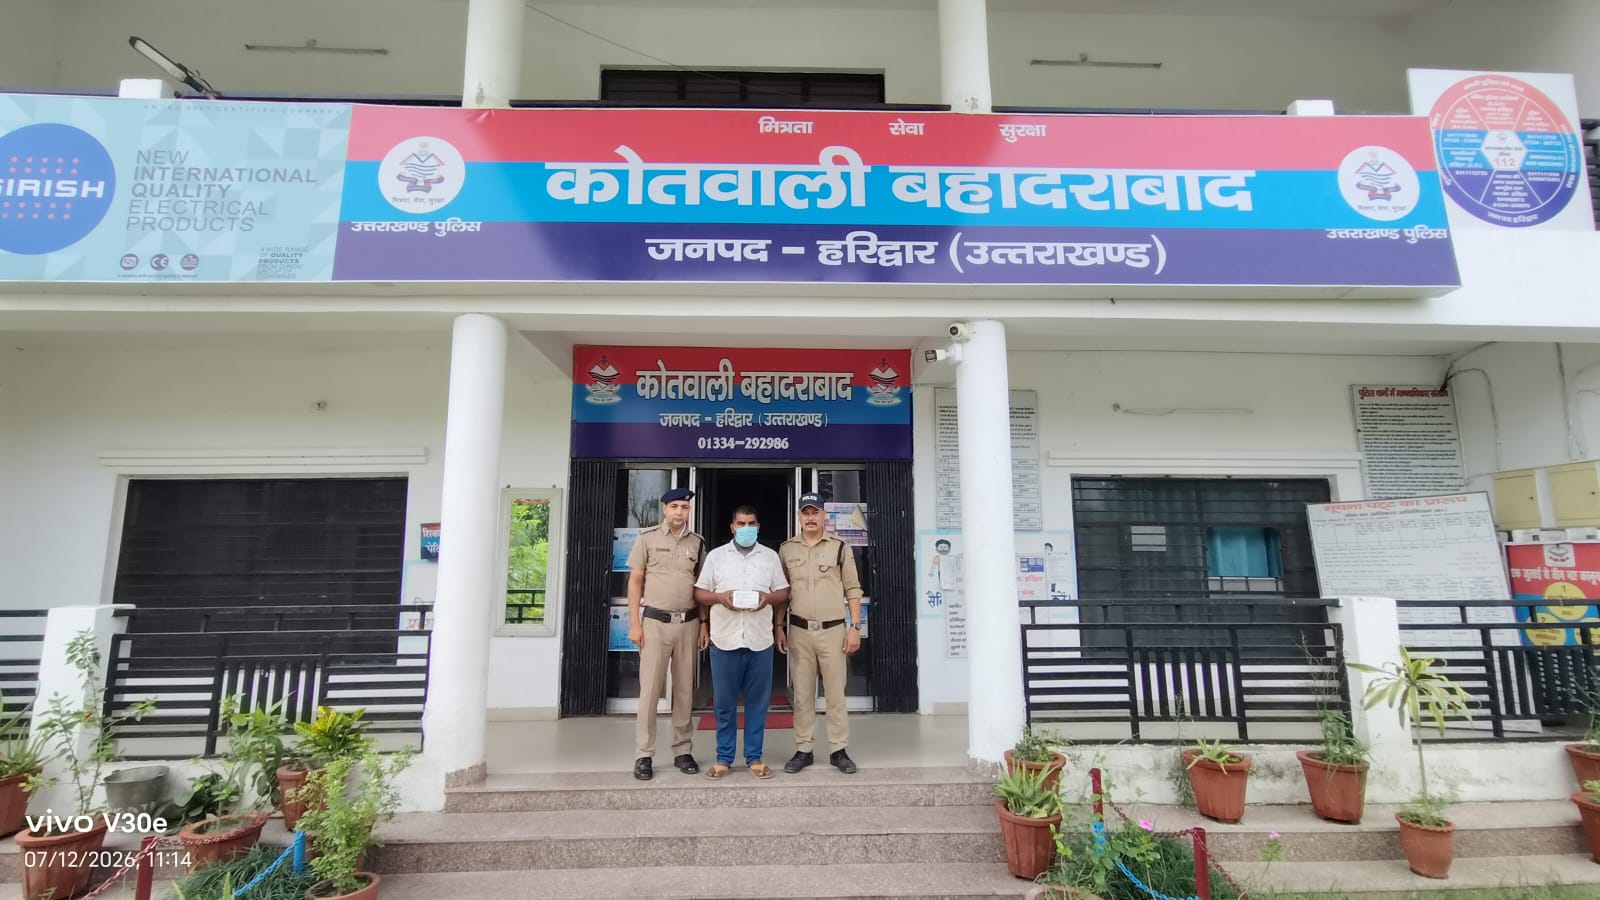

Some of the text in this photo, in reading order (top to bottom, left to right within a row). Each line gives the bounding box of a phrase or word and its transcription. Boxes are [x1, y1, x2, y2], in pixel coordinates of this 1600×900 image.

[758, 115, 1046, 143] मित्रता सेवा सुरक्षा
[136, 149, 189, 165] NEW
[133, 166, 318, 183] INTERNATIONAL
[544, 145, 1256, 214] कोतवाली बहादराबाद
[0, 178, 105, 199] IRISH
[130, 183, 232, 199] QUALITY
[128, 200, 270, 216] ELECTRICAL
[126, 216, 255, 233] PRODUCTS
[351, 217, 482, 238] उत्तराखण्ड पुलिस
[1325, 224, 1448, 244] उत्तराखण्ड पुलिस
[644, 238, 772, 263] जनपद
[816, 230, 938, 267] हरिद्वार
[949, 232, 1166, 275] (उत्तराखण्ड)
[636, 358, 854, 404] कोतवाली बहादराबाद
[659, 412, 701, 427] जनपद
[715, 407, 753, 428] हरिद्वार
[697, 436, 789, 450] 01334-292986
